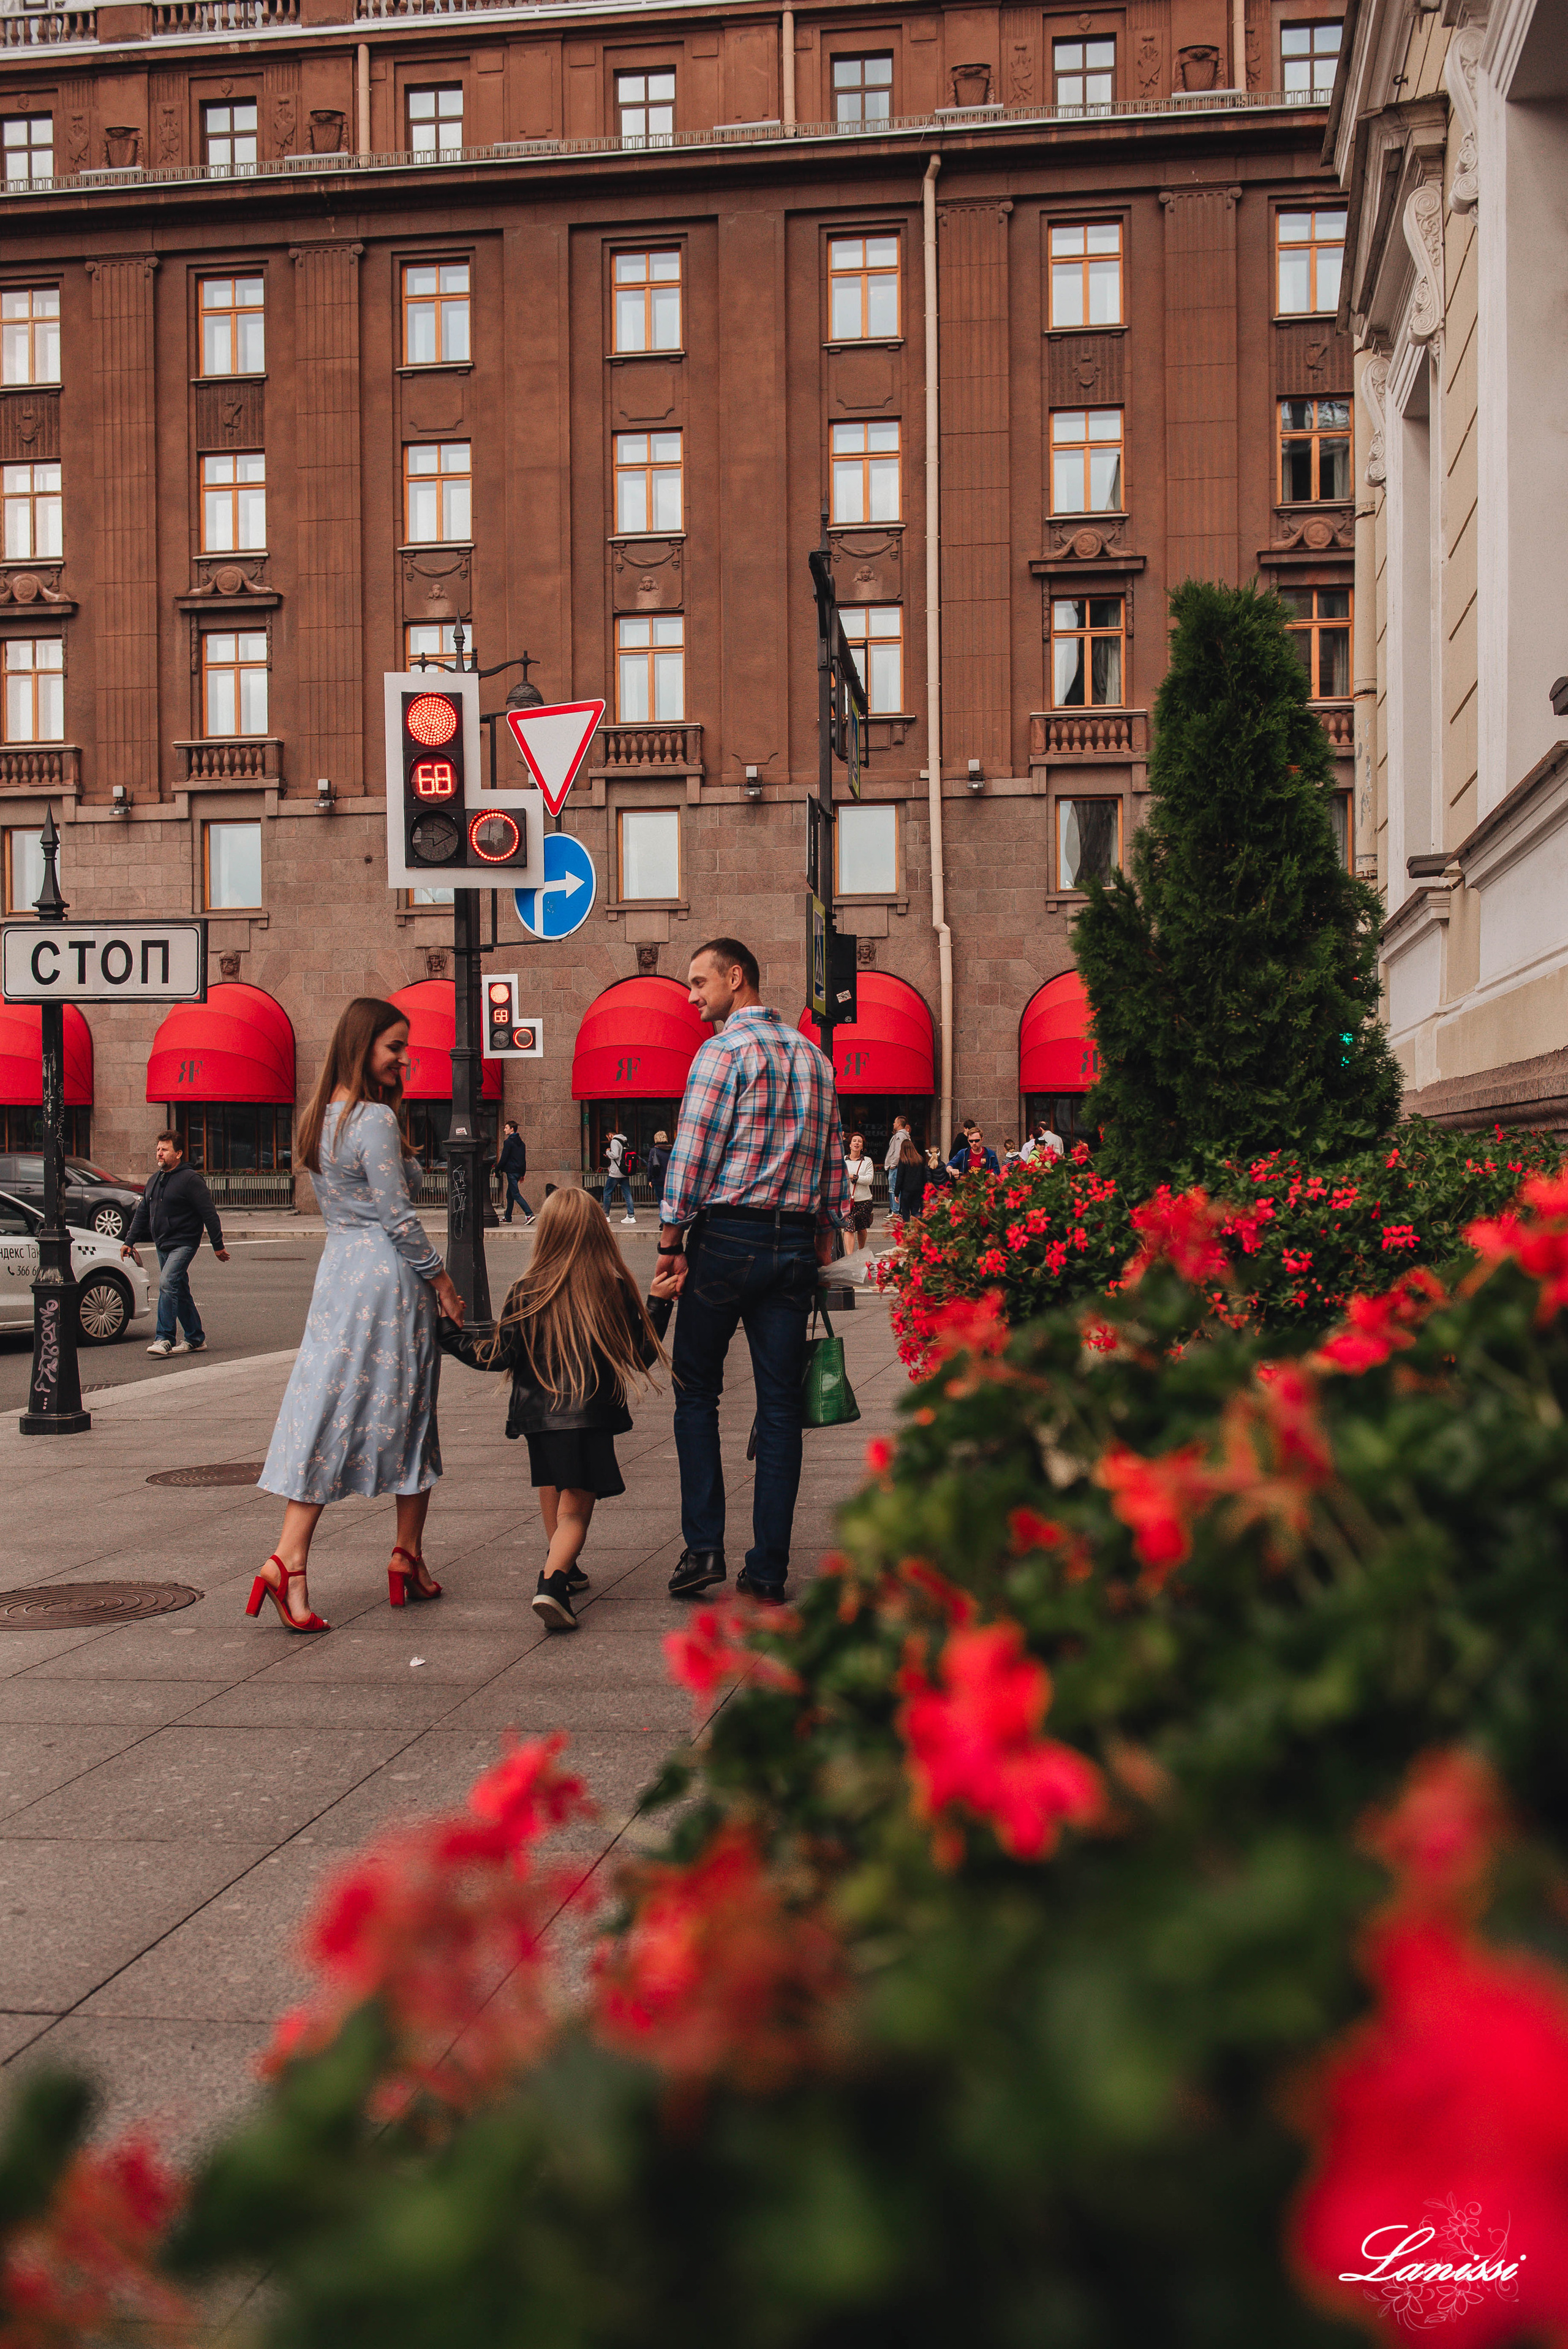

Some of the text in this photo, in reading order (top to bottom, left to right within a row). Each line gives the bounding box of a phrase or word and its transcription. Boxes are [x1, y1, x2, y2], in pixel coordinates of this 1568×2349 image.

[418, 764, 451, 795] 68
[31, 939, 170, 985] СТОП
[494, 1010, 508, 1022] 68
[17, 1266, 30, 1276] 366
